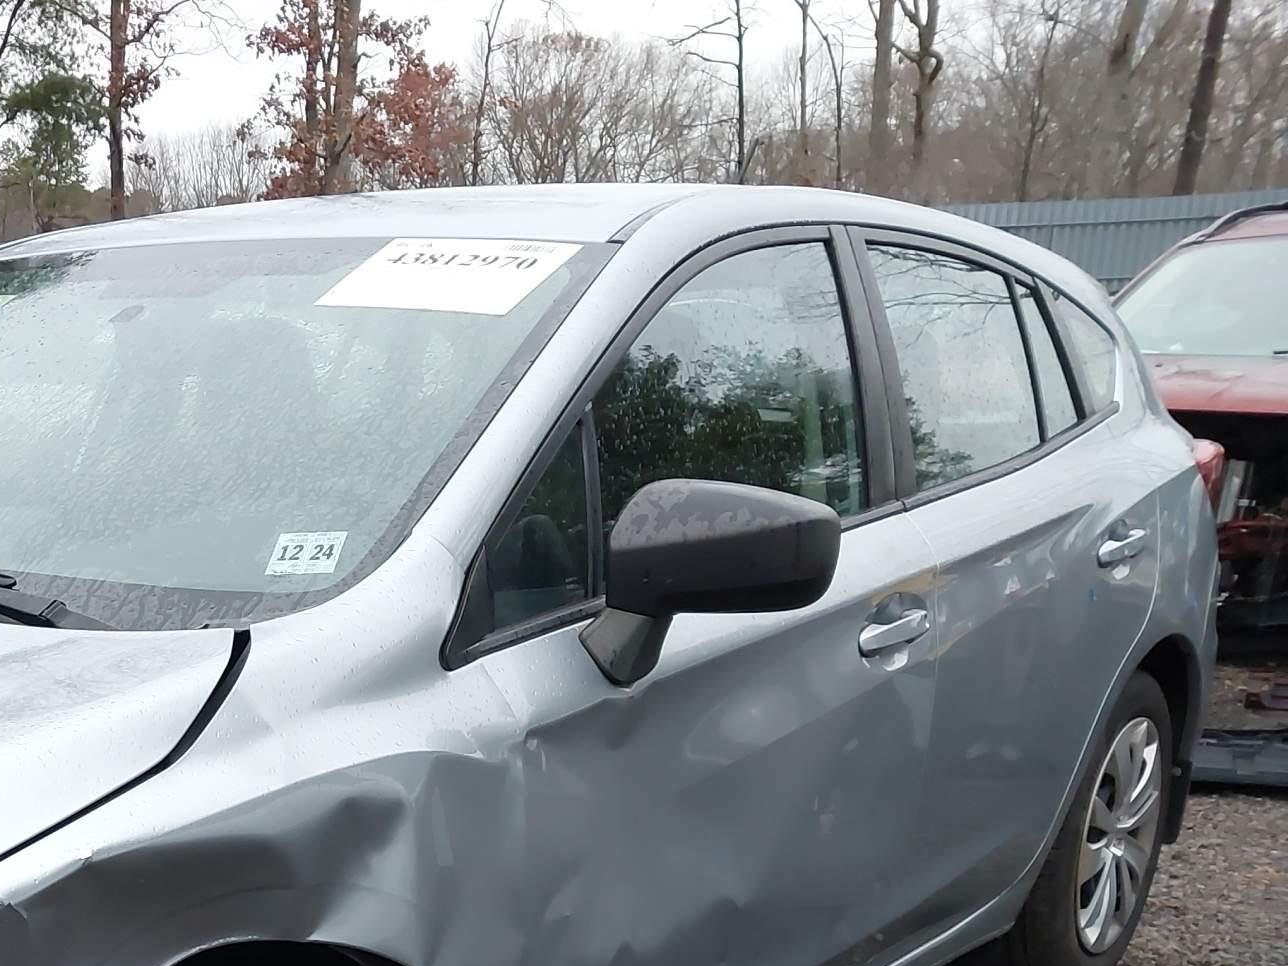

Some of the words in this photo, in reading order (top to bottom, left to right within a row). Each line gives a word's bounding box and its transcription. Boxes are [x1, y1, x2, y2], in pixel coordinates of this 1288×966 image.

[387, 252, 538, 270] 43812970
[277, 544, 304, 561] 12
[309, 543, 336, 561] 24
